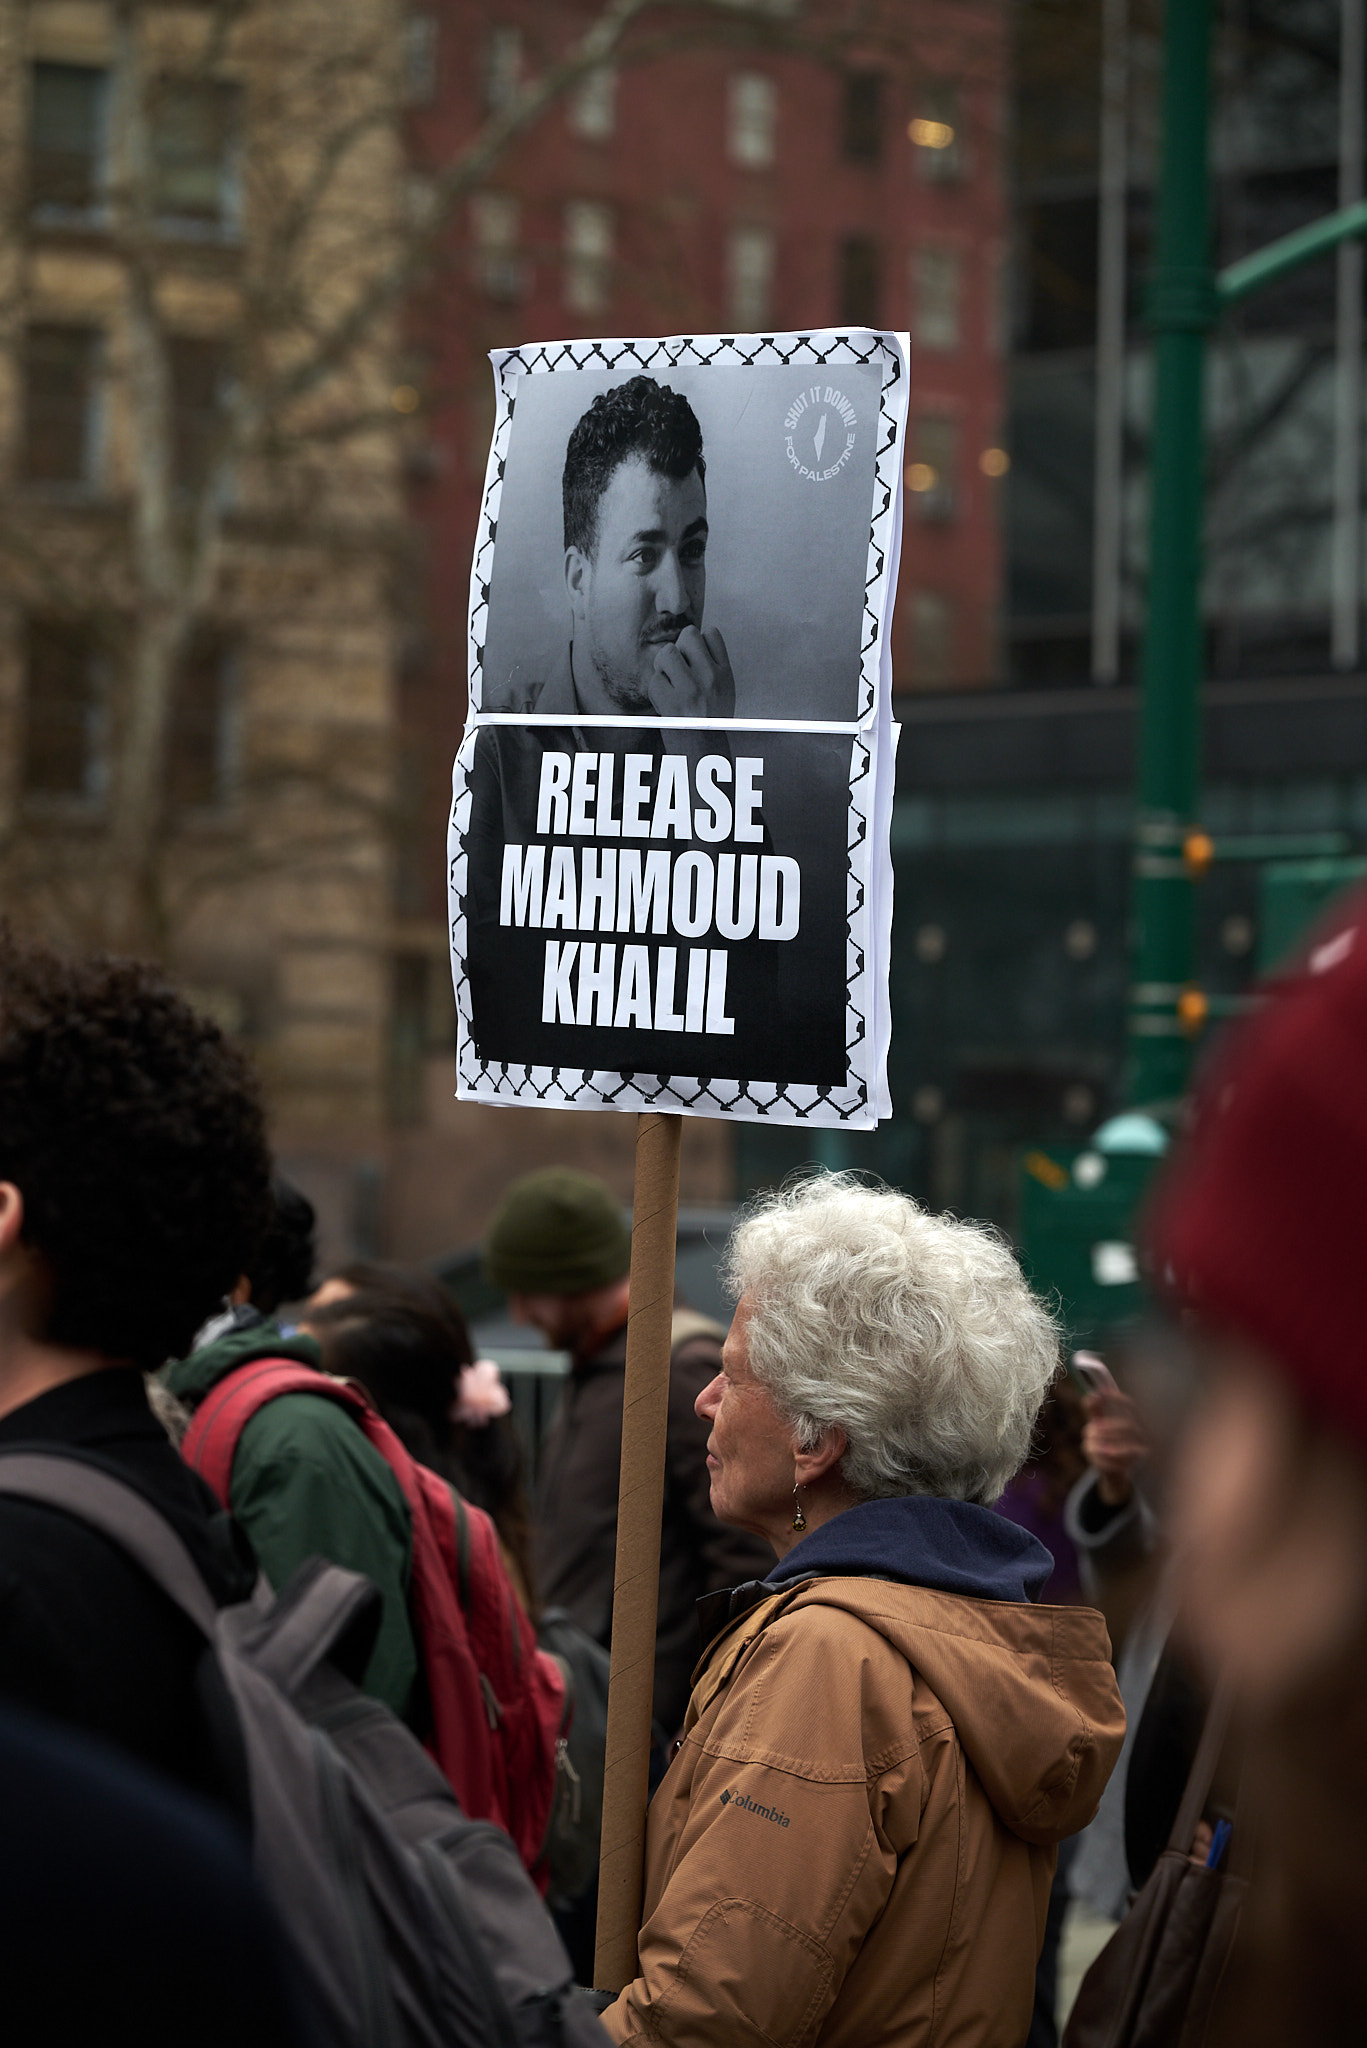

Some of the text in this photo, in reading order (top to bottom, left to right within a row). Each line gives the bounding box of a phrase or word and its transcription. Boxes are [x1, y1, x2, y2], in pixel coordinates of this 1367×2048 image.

[784, 386, 858, 430] SHUT IT DOWN!
[784, 433, 856, 482] FOR PALESTINE
[536, 751, 764, 843] RELEASE
[500, 843, 801, 941] MAHMOUD
[541, 940, 735, 1035] KHALIL
[729, 1790, 791, 1828] Columbia
